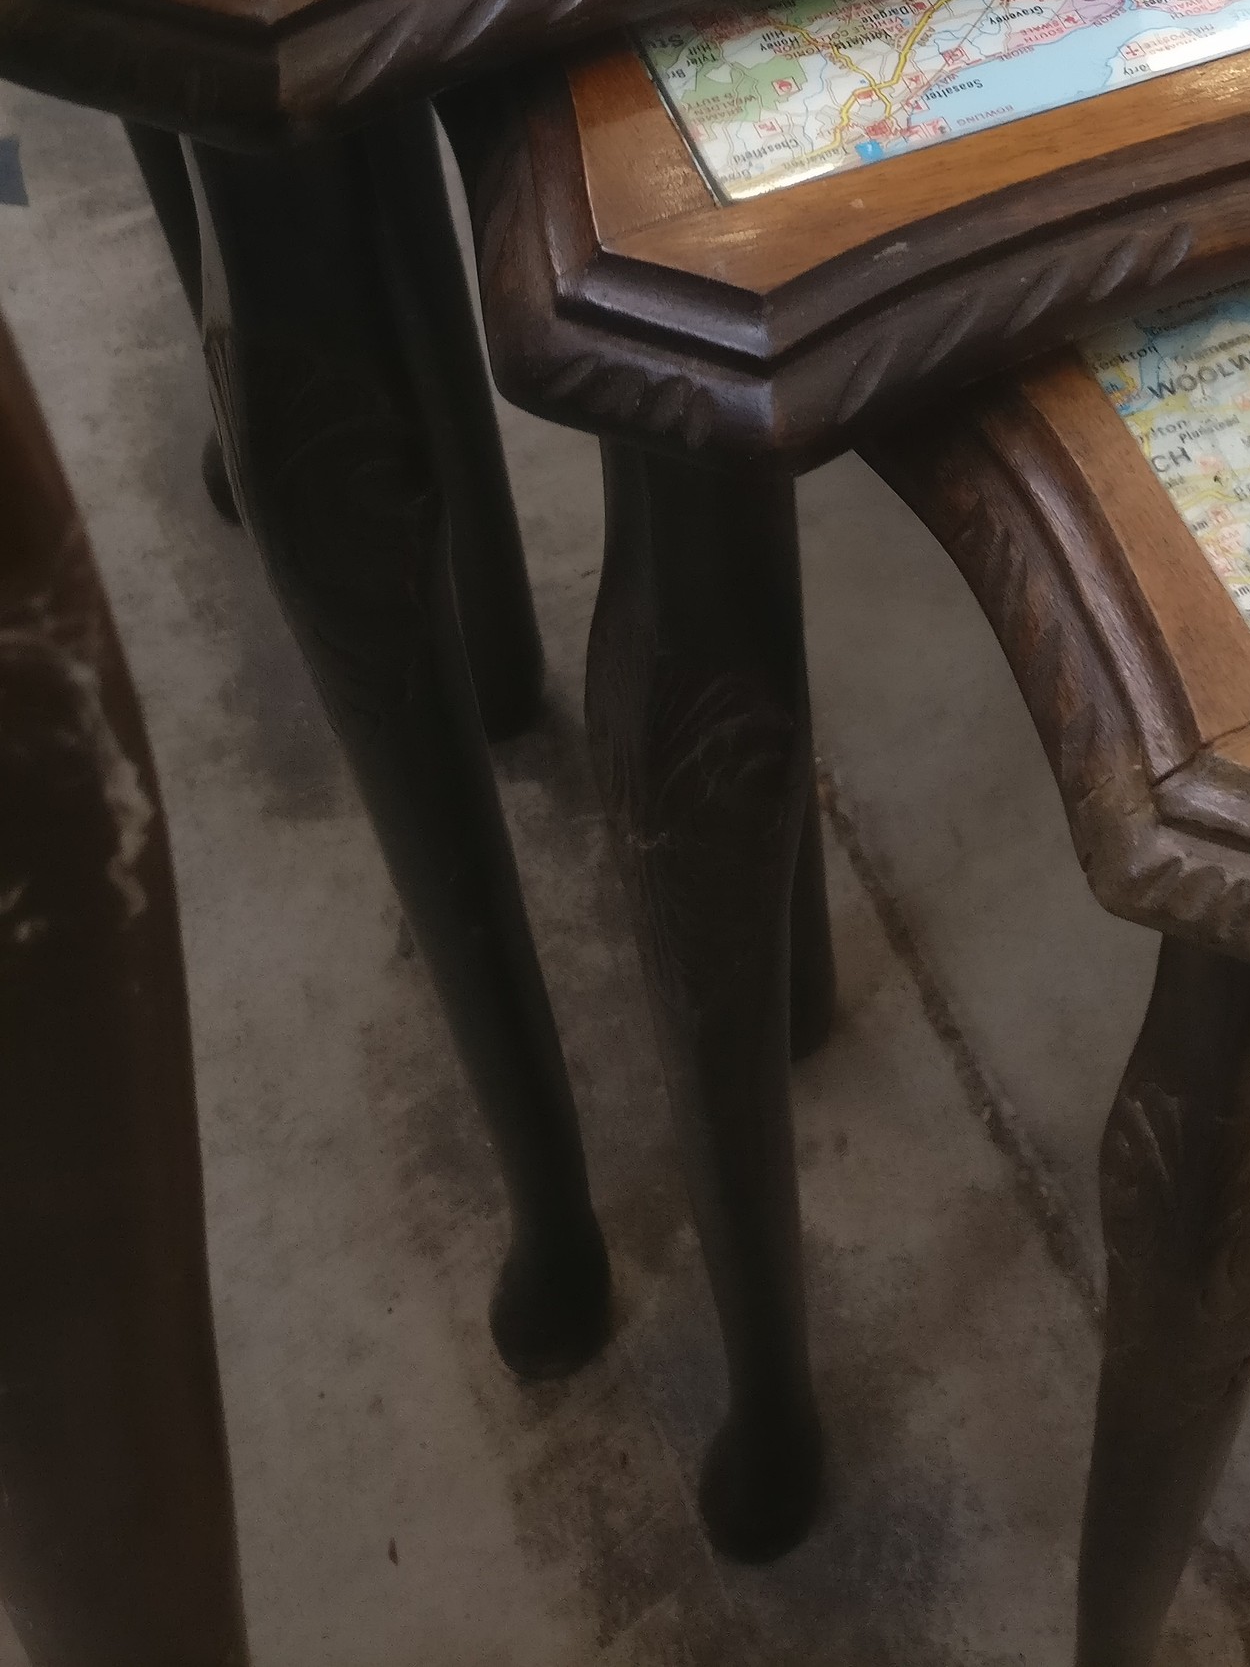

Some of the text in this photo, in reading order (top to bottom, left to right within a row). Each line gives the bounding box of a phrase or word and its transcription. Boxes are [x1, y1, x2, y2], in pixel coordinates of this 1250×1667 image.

[987, 3, 1043, 27] Graveney
[760, 29, 784, 41] Hill
[922, 77, 983, 102] Seasalter
